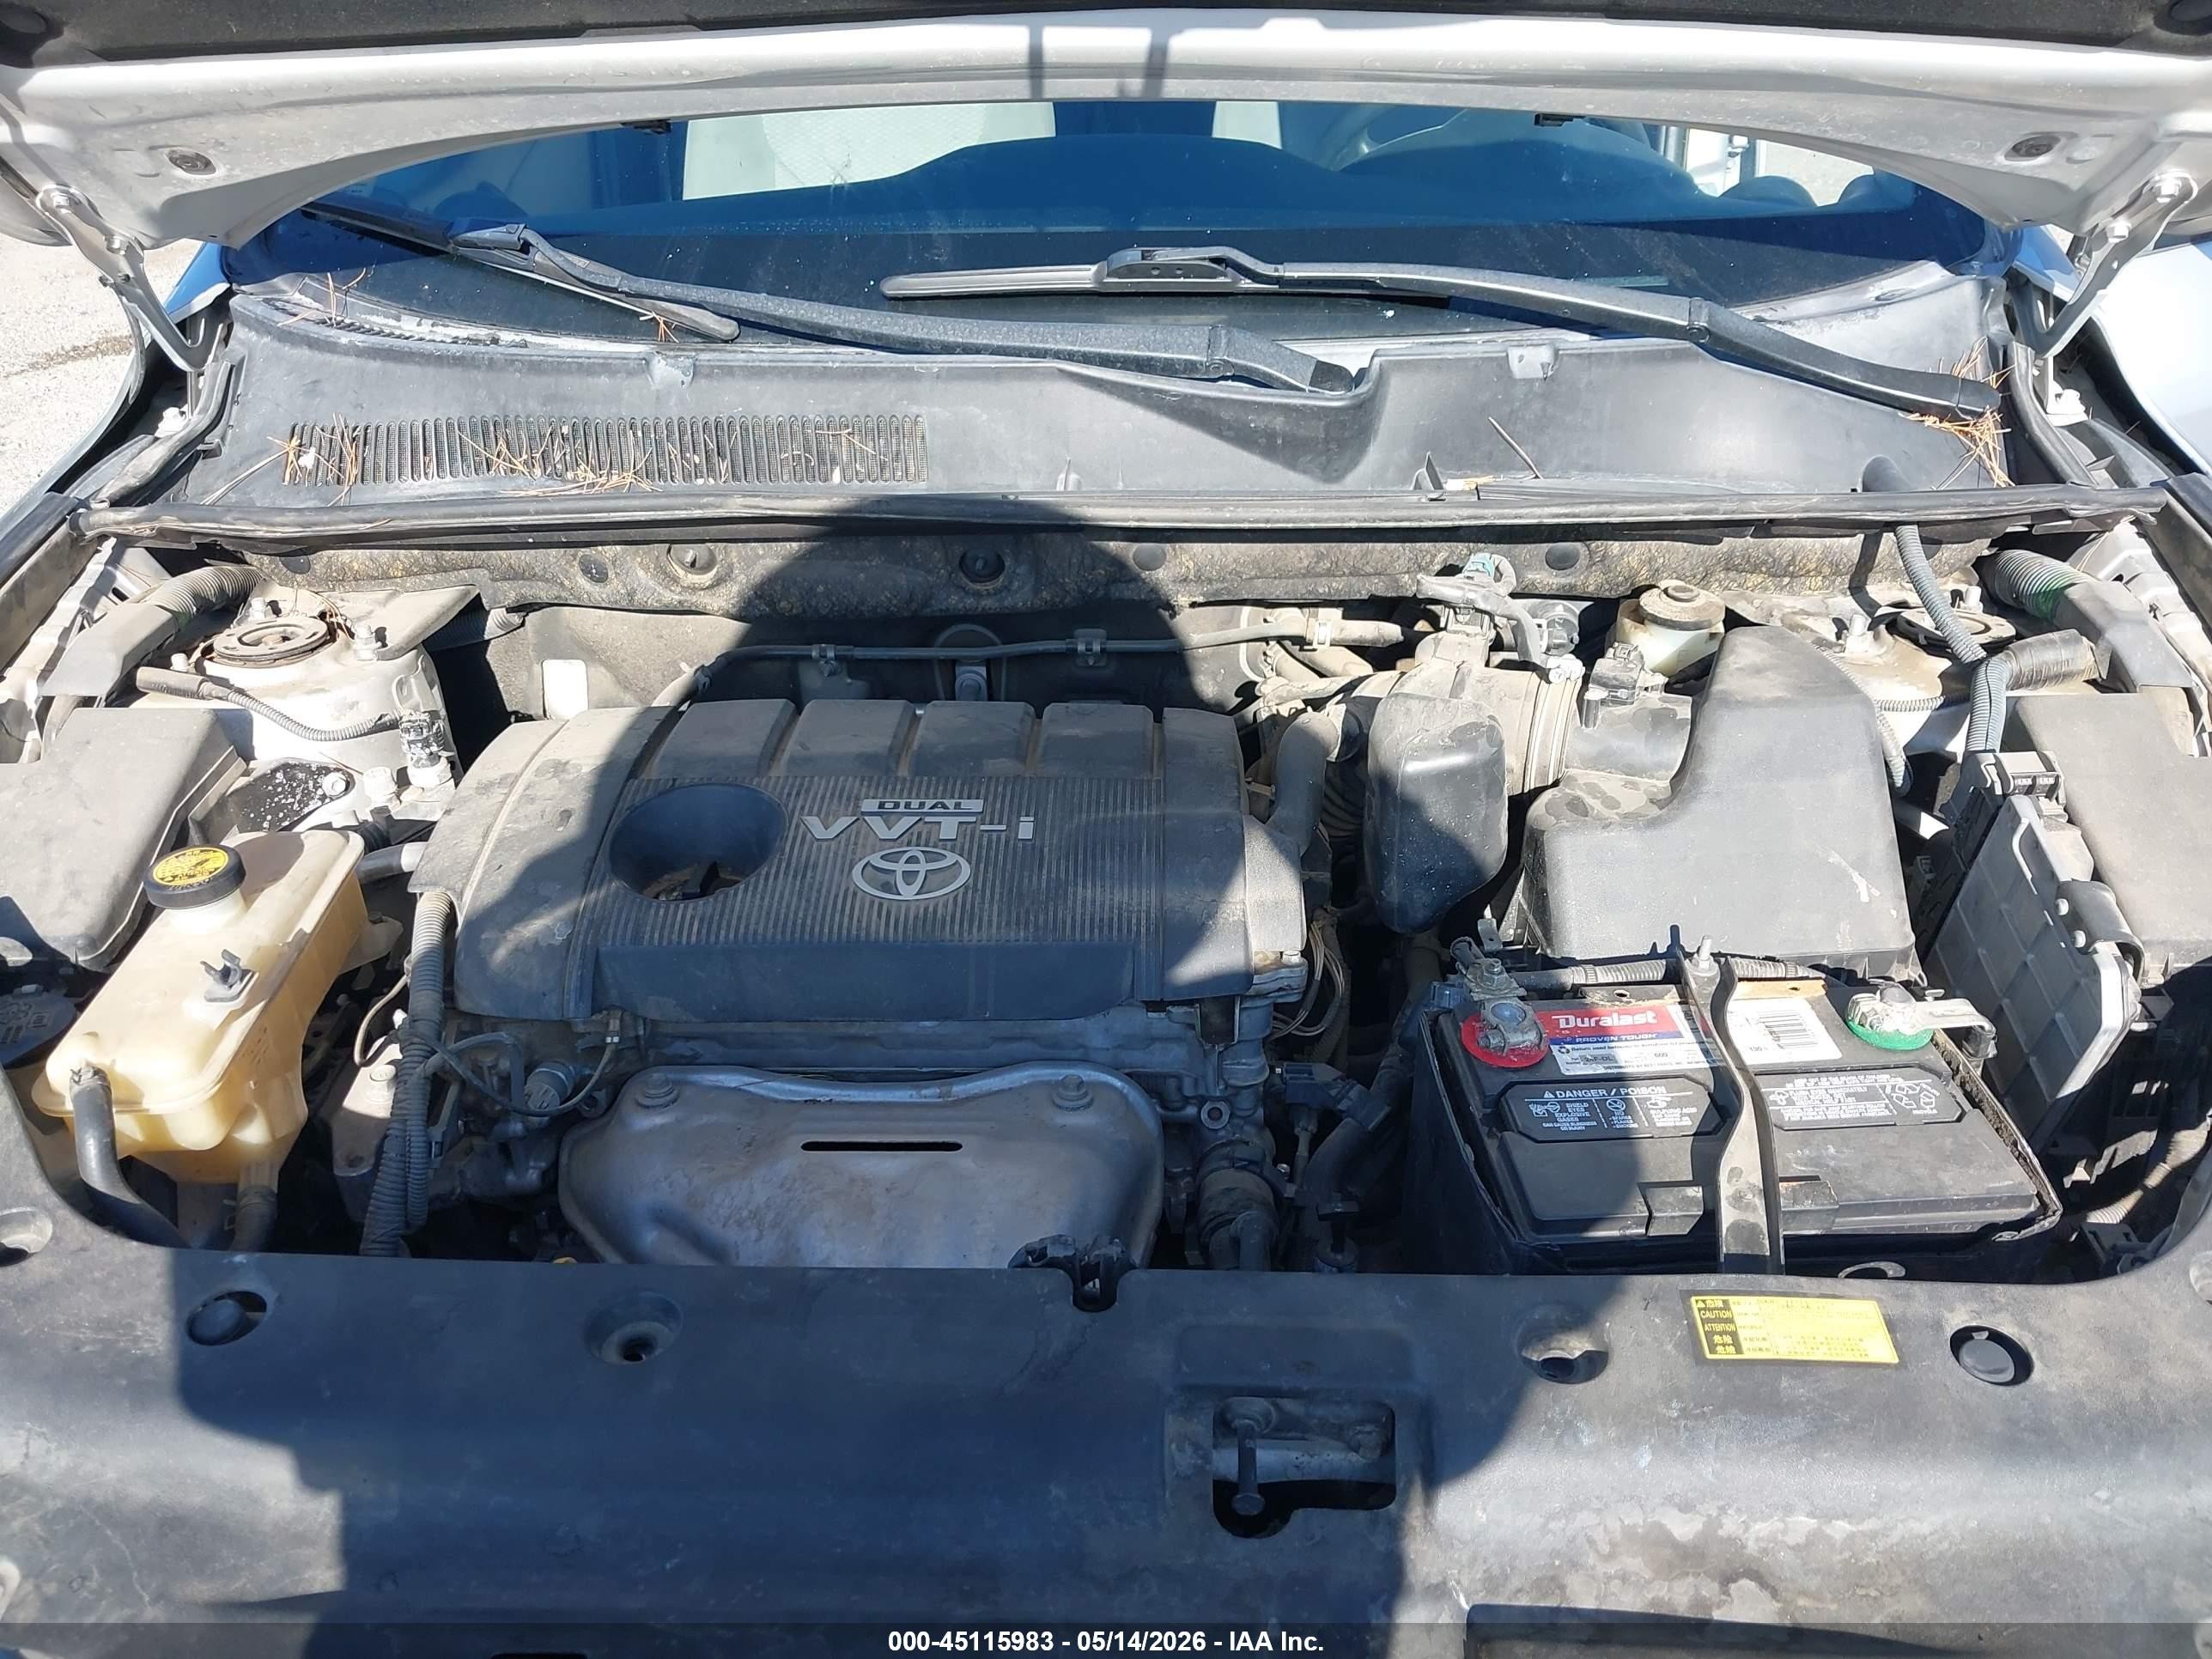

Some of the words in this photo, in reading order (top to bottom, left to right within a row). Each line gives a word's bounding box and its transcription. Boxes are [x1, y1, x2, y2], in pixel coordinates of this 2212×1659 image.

[878, 800, 975, 810] DUAL
[800, 816, 1035, 840] VVT-i
[1552, 1010, 1658, 1029] Duralast
[1555, 1089, 1607, 1098] DANGER
[1620, 1085, 1667, 1096] POISON
[1700, 1310, 1733, 1319] CAUTION
[1705, 1323, 1736, 1332] ATTENTION
